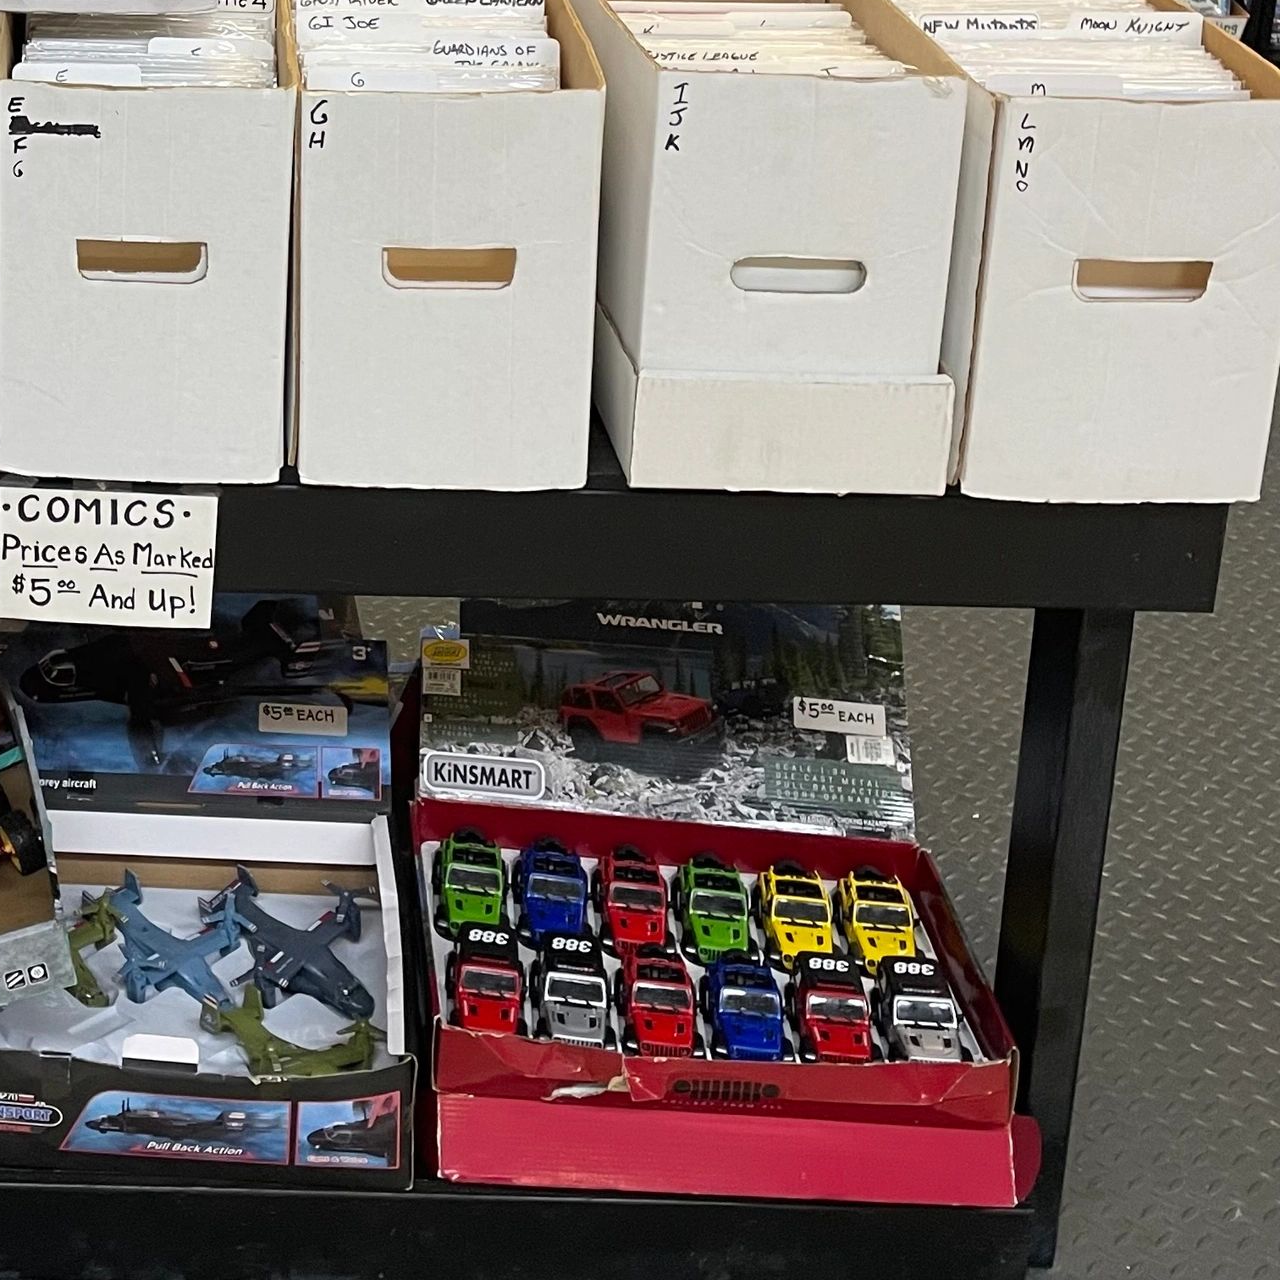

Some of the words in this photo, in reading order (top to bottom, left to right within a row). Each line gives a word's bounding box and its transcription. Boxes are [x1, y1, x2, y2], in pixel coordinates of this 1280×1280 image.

[308, 16, 333, 30] GI
[344, 16, 380, 30] JOE
[1080, 17, 1117, 31] MOON
[1125, 17, 1190, 35] KNIGHT
[432, 40, 507, 56] GUARDIANS
[515, 45, 536, 56] OF
[702, 51, 760, 61] LEAGUE
[8, 97, 25, 112] E
[310, 99, 328, 125] G
[669, 107, 688, 126] J
[1021, 113, 1036, 130] L
[13, 137, 27, 154] F
[309, 130, 325, 148] H
[665, 133, 680, 152] K
[1016, 160, 1029, 178] N
[2, 533, 88, 565] Prices
[94, 543, 125, 566] As
[132, 542, 214, 569] Marked
[89, 584, 135, 610] And
[149, 585, 196, 619] Up!
[597, 612, 724, 635] WRANGLER
[297, 709, 335, 723] EACH
[838, 711, 875, 725] EACH
[775, 763, 811, 772] SCALE
[62, 777, 97, 789] aircraft
[237, 781, 252, 790] Pull
[775, 772, 795, 780] DIE
[804, 774, 833, 783] CAST
[842, 778, 880, 788] METAL
[775, 781, 804, 789] PULL
[467, 928, 510, 947] 388
[551, 936, 593, 954] 388
[808, 957, 851, 974] 388
[894, 961, 936, 977] 388
[146, 1140, 170, 1152] Pull
[172, 1141, 201, 1153] Back
[204, 1144, 243, 1157] Action
